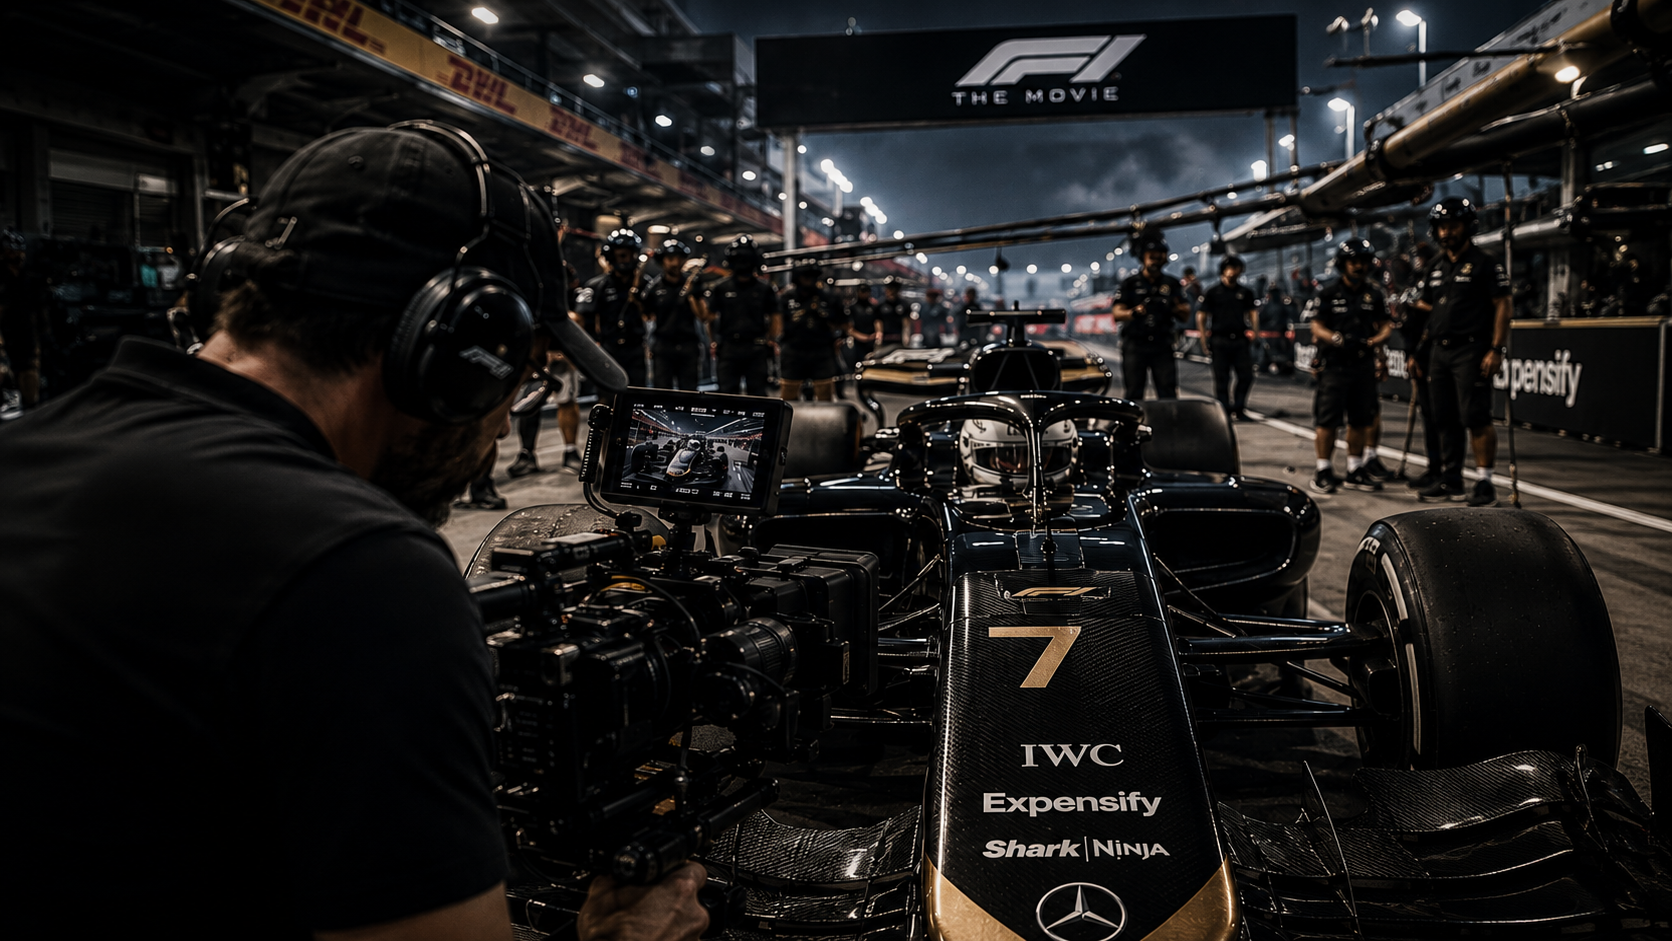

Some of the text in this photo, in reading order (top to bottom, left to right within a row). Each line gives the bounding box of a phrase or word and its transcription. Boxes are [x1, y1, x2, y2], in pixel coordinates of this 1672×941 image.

[954, 33, 1148, 87] F1
[448, 53, 516, 115] DHL
[950, 86, 1119, 107] THE MOVIE
[988, 626, 1082, 689] 7
[1020, 743, 1125, 768] IWC
[982, 791, 1163, 817] Expensify
